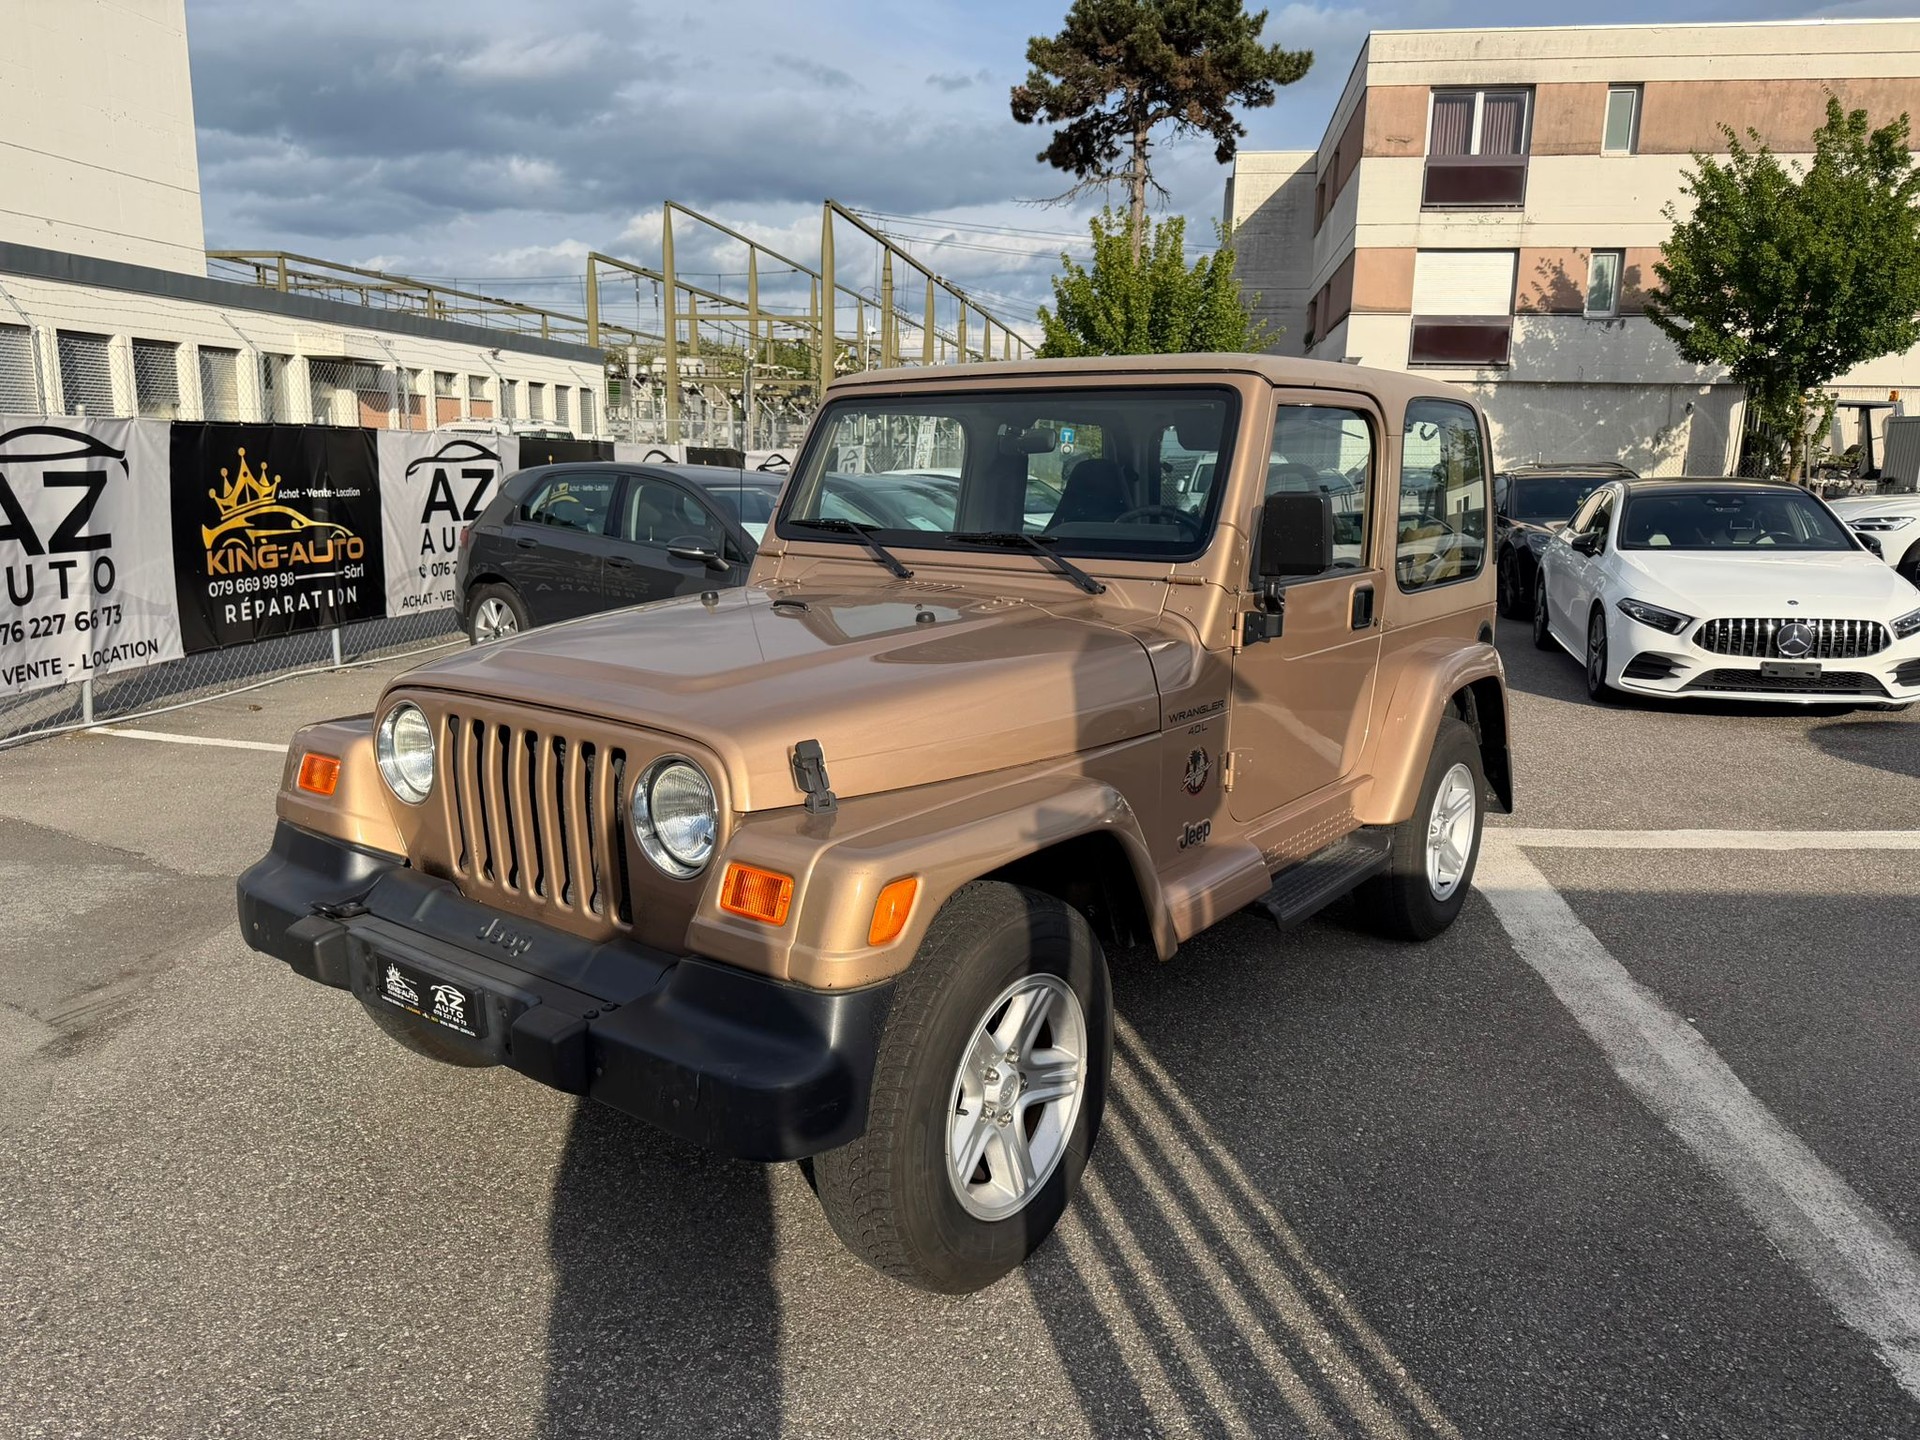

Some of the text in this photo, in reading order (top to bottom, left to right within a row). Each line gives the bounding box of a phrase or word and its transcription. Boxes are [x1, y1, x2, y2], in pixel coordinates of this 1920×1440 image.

[278, 489, 299, 499] Achat
[306, 488, 332, 498] Vente
[336, 488, 360, 498] Location
[421, 468, 495, 524] AZ
[431, 561, 450, 577] 076
[208, 581, 234, 598] 079
[236, 577, 260, 594] 669
[262, 574, 278, 590] 99
[280, 571, 295, 586] 98
[225, 585, 357, 625] RÉPARATION
[402, 592, 433, 609] ACHAT
[28, 613, 66, 640] 227
[75, 608, 99, 632] 66
[102, 604, 122, 627] 73
[3, 657, 62, 686] VENTE
[82, 638, 159, 671] LOCATION
[1168, 699, 1225, 723] WRANGLER
[1178, 819, 1212, 850] Jeep
[475, 918, 534, 957] Jeep
[435, 990, 464, 1012] AZ
[435, 1003, 464, 1019] AUTO
